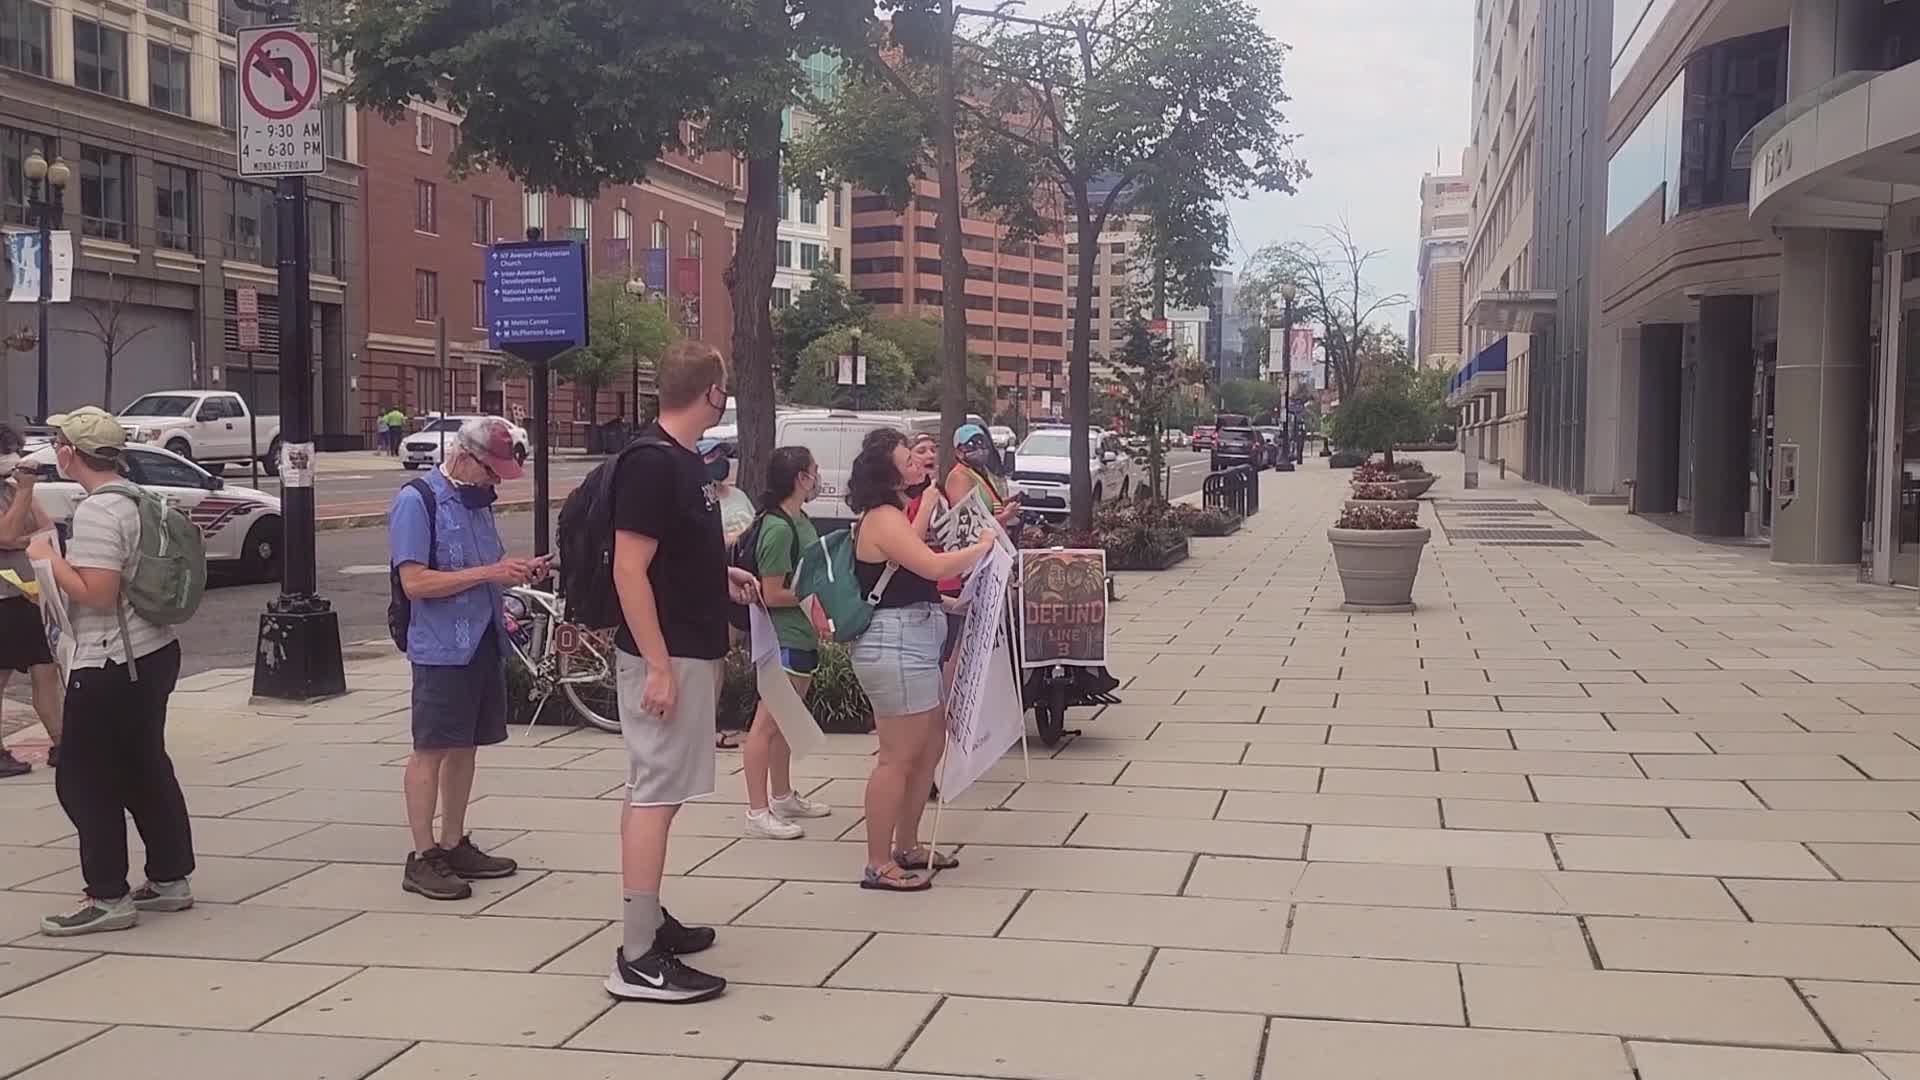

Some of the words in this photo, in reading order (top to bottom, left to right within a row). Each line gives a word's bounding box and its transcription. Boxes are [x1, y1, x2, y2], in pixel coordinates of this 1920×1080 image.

[242, 126, 249, 139] 7
[267, 124, 293, 138] 9:30
[303, 123, 320, 137] AM
[242, 144, 249, 158] 4
[268, 142, 295, 157] 6:30
[303, 142, 321, 156] PM
[1024, 600, 1104, 625] DEFUND
[1048, 627, 1082, 641] LINE
